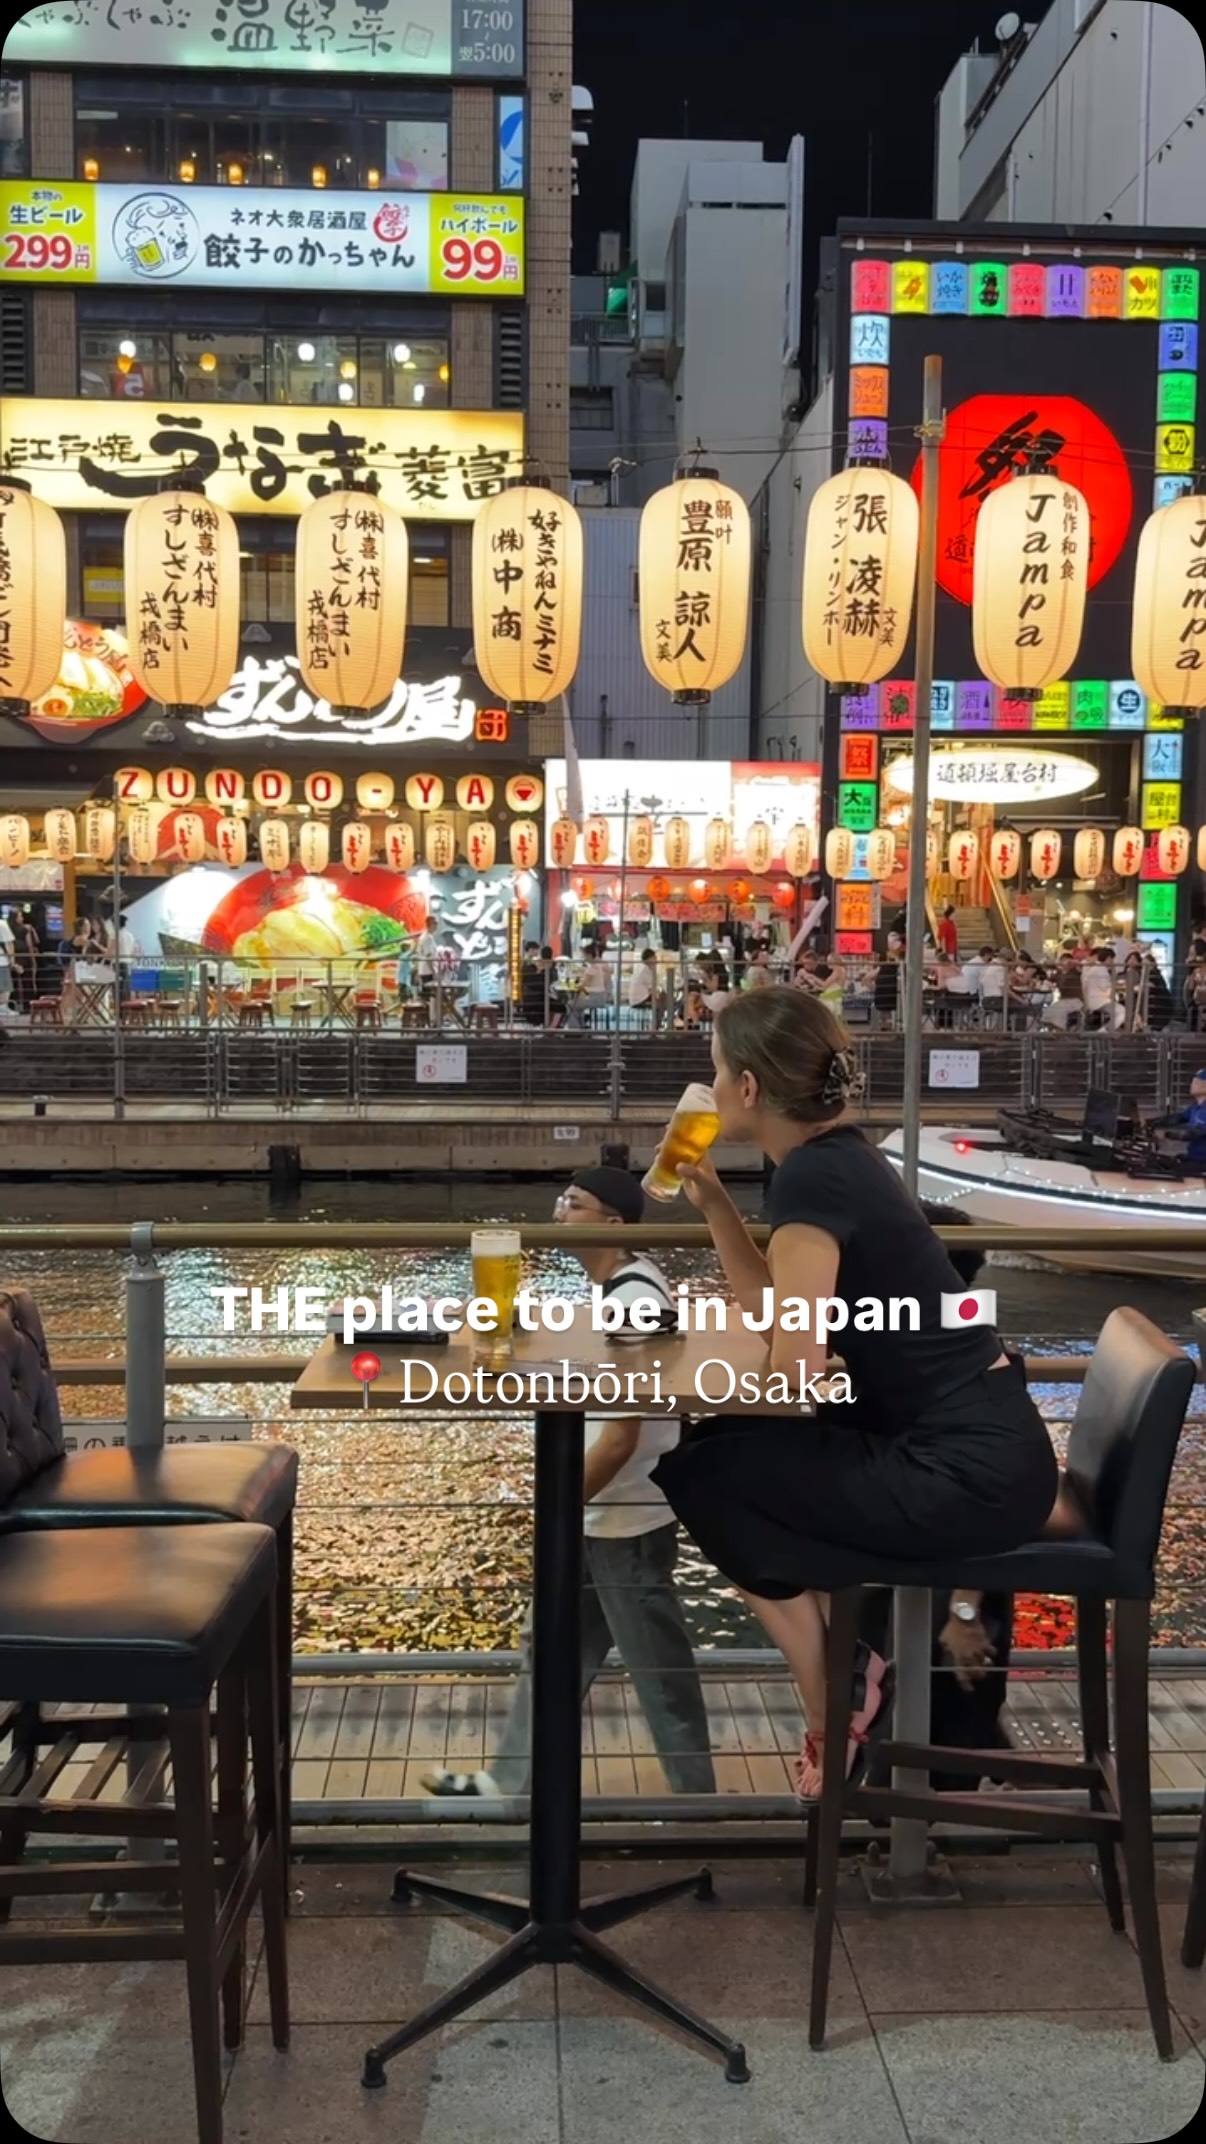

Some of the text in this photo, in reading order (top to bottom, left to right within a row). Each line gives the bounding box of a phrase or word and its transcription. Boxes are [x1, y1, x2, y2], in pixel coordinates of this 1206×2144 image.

[461, 9, 513, 29] 17:00
[10, 205, 83, 224] 生ビール
[231, 208, 368, 230] ネオ大衆居酒屋
[441, 218, 518, 233] ハイボール
[204, 233, 415, 269] 餃子のかっちゃん
[11, 434, 141, 463] 江戸焼
[79, 413, 386, 501] うなぎ
[395, 444, 510, 500] 菱富
[1059, 491, 1079, 581] 創作和食
[162, 504, 190, 651] すしざんまい
[328, 508, 353, 656] すしざんまい
[527, 509, 562, 674] 好きやねんミナミ
[1015, 494, 1056, 647] Jampa
[937, 763, 1057, 784] 道頓堀屋台村
